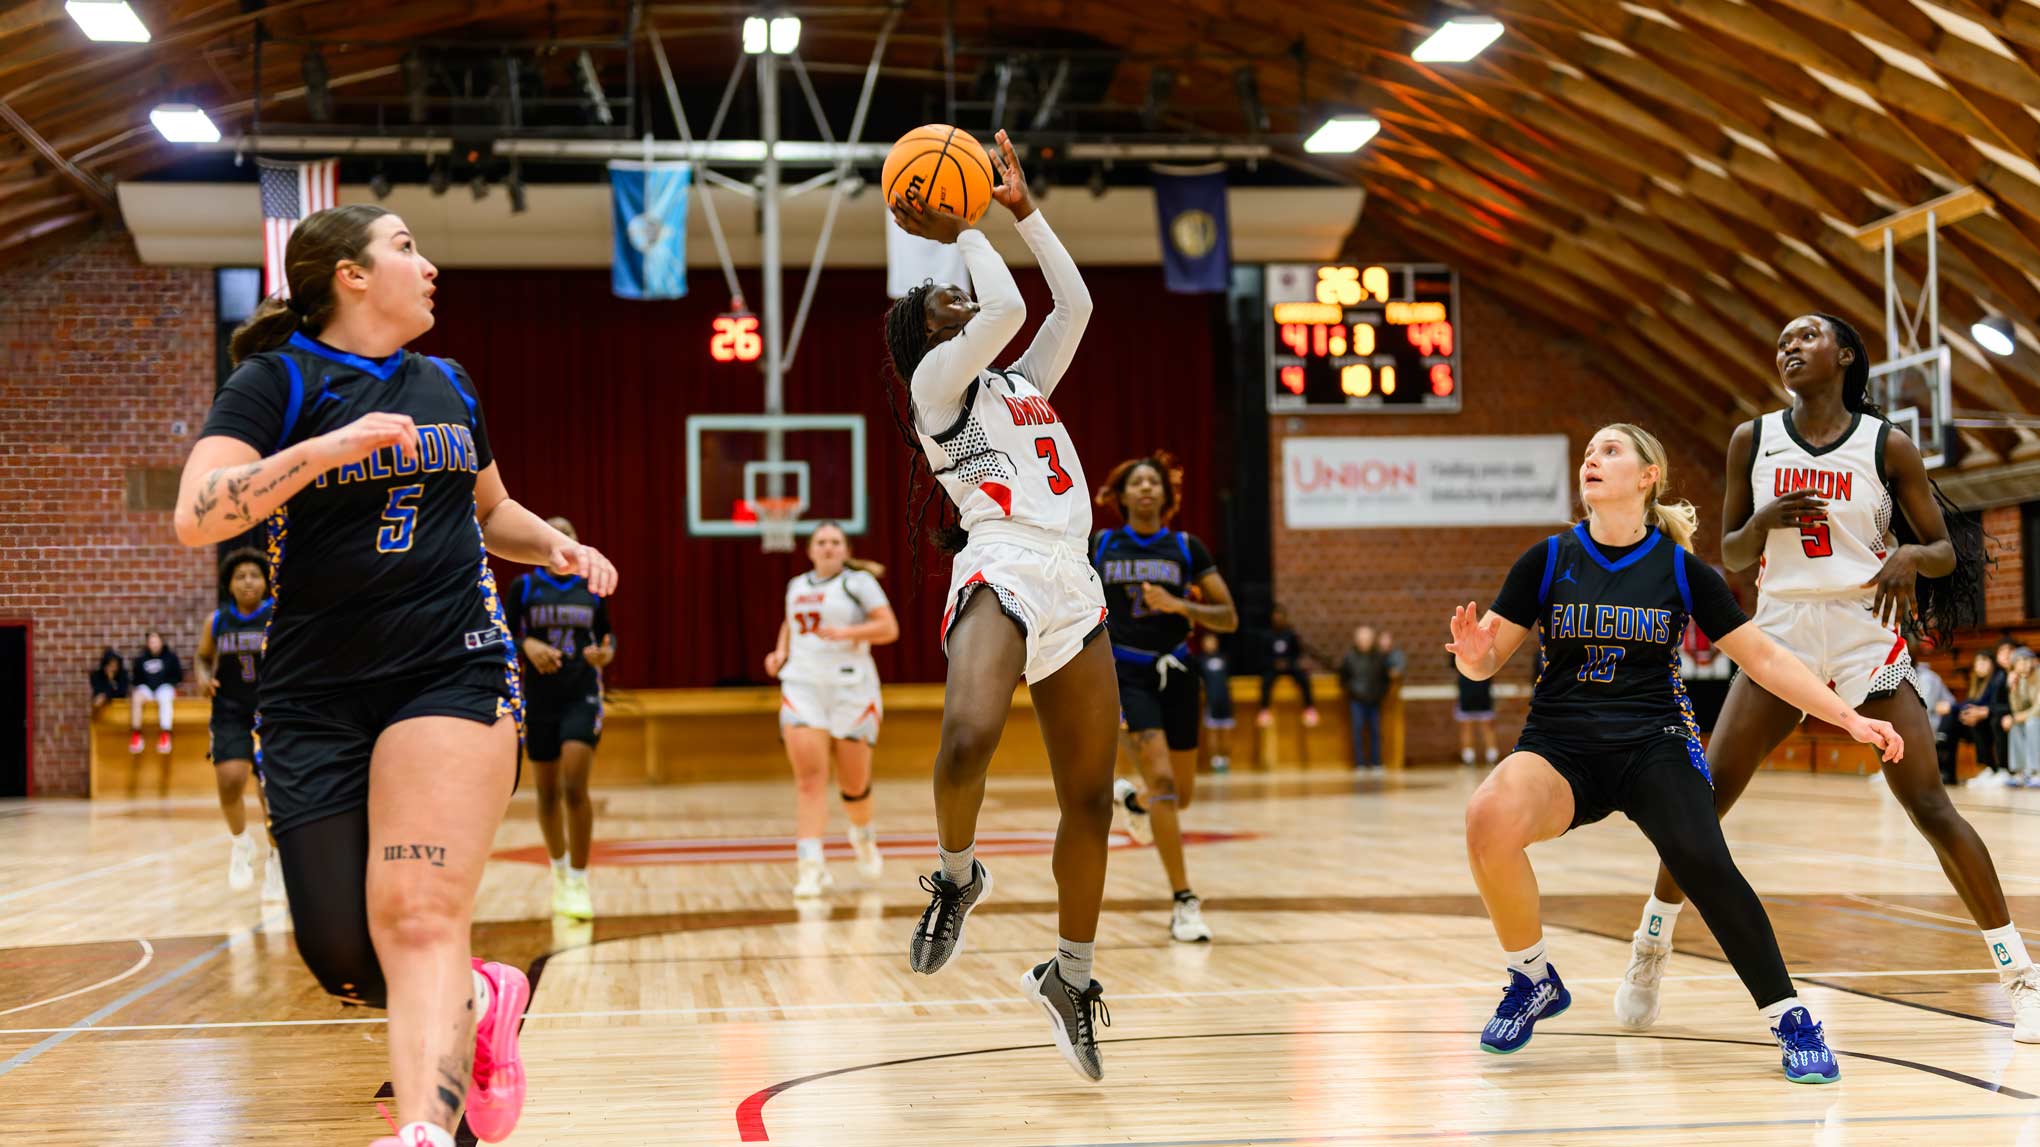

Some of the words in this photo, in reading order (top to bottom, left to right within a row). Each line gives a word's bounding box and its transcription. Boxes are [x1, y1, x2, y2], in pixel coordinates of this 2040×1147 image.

[710, 317, 763, 362] 26
[1034, 436, 1075, 496] 3
[1774, 467, 1853, 502] UNION
[376, 483, 425, 555] 5
[1799, 512, 1833, 559] 5
[1551, 603, 1673, 645] FALCONS
[1577, 644, 1627, 685] 10
